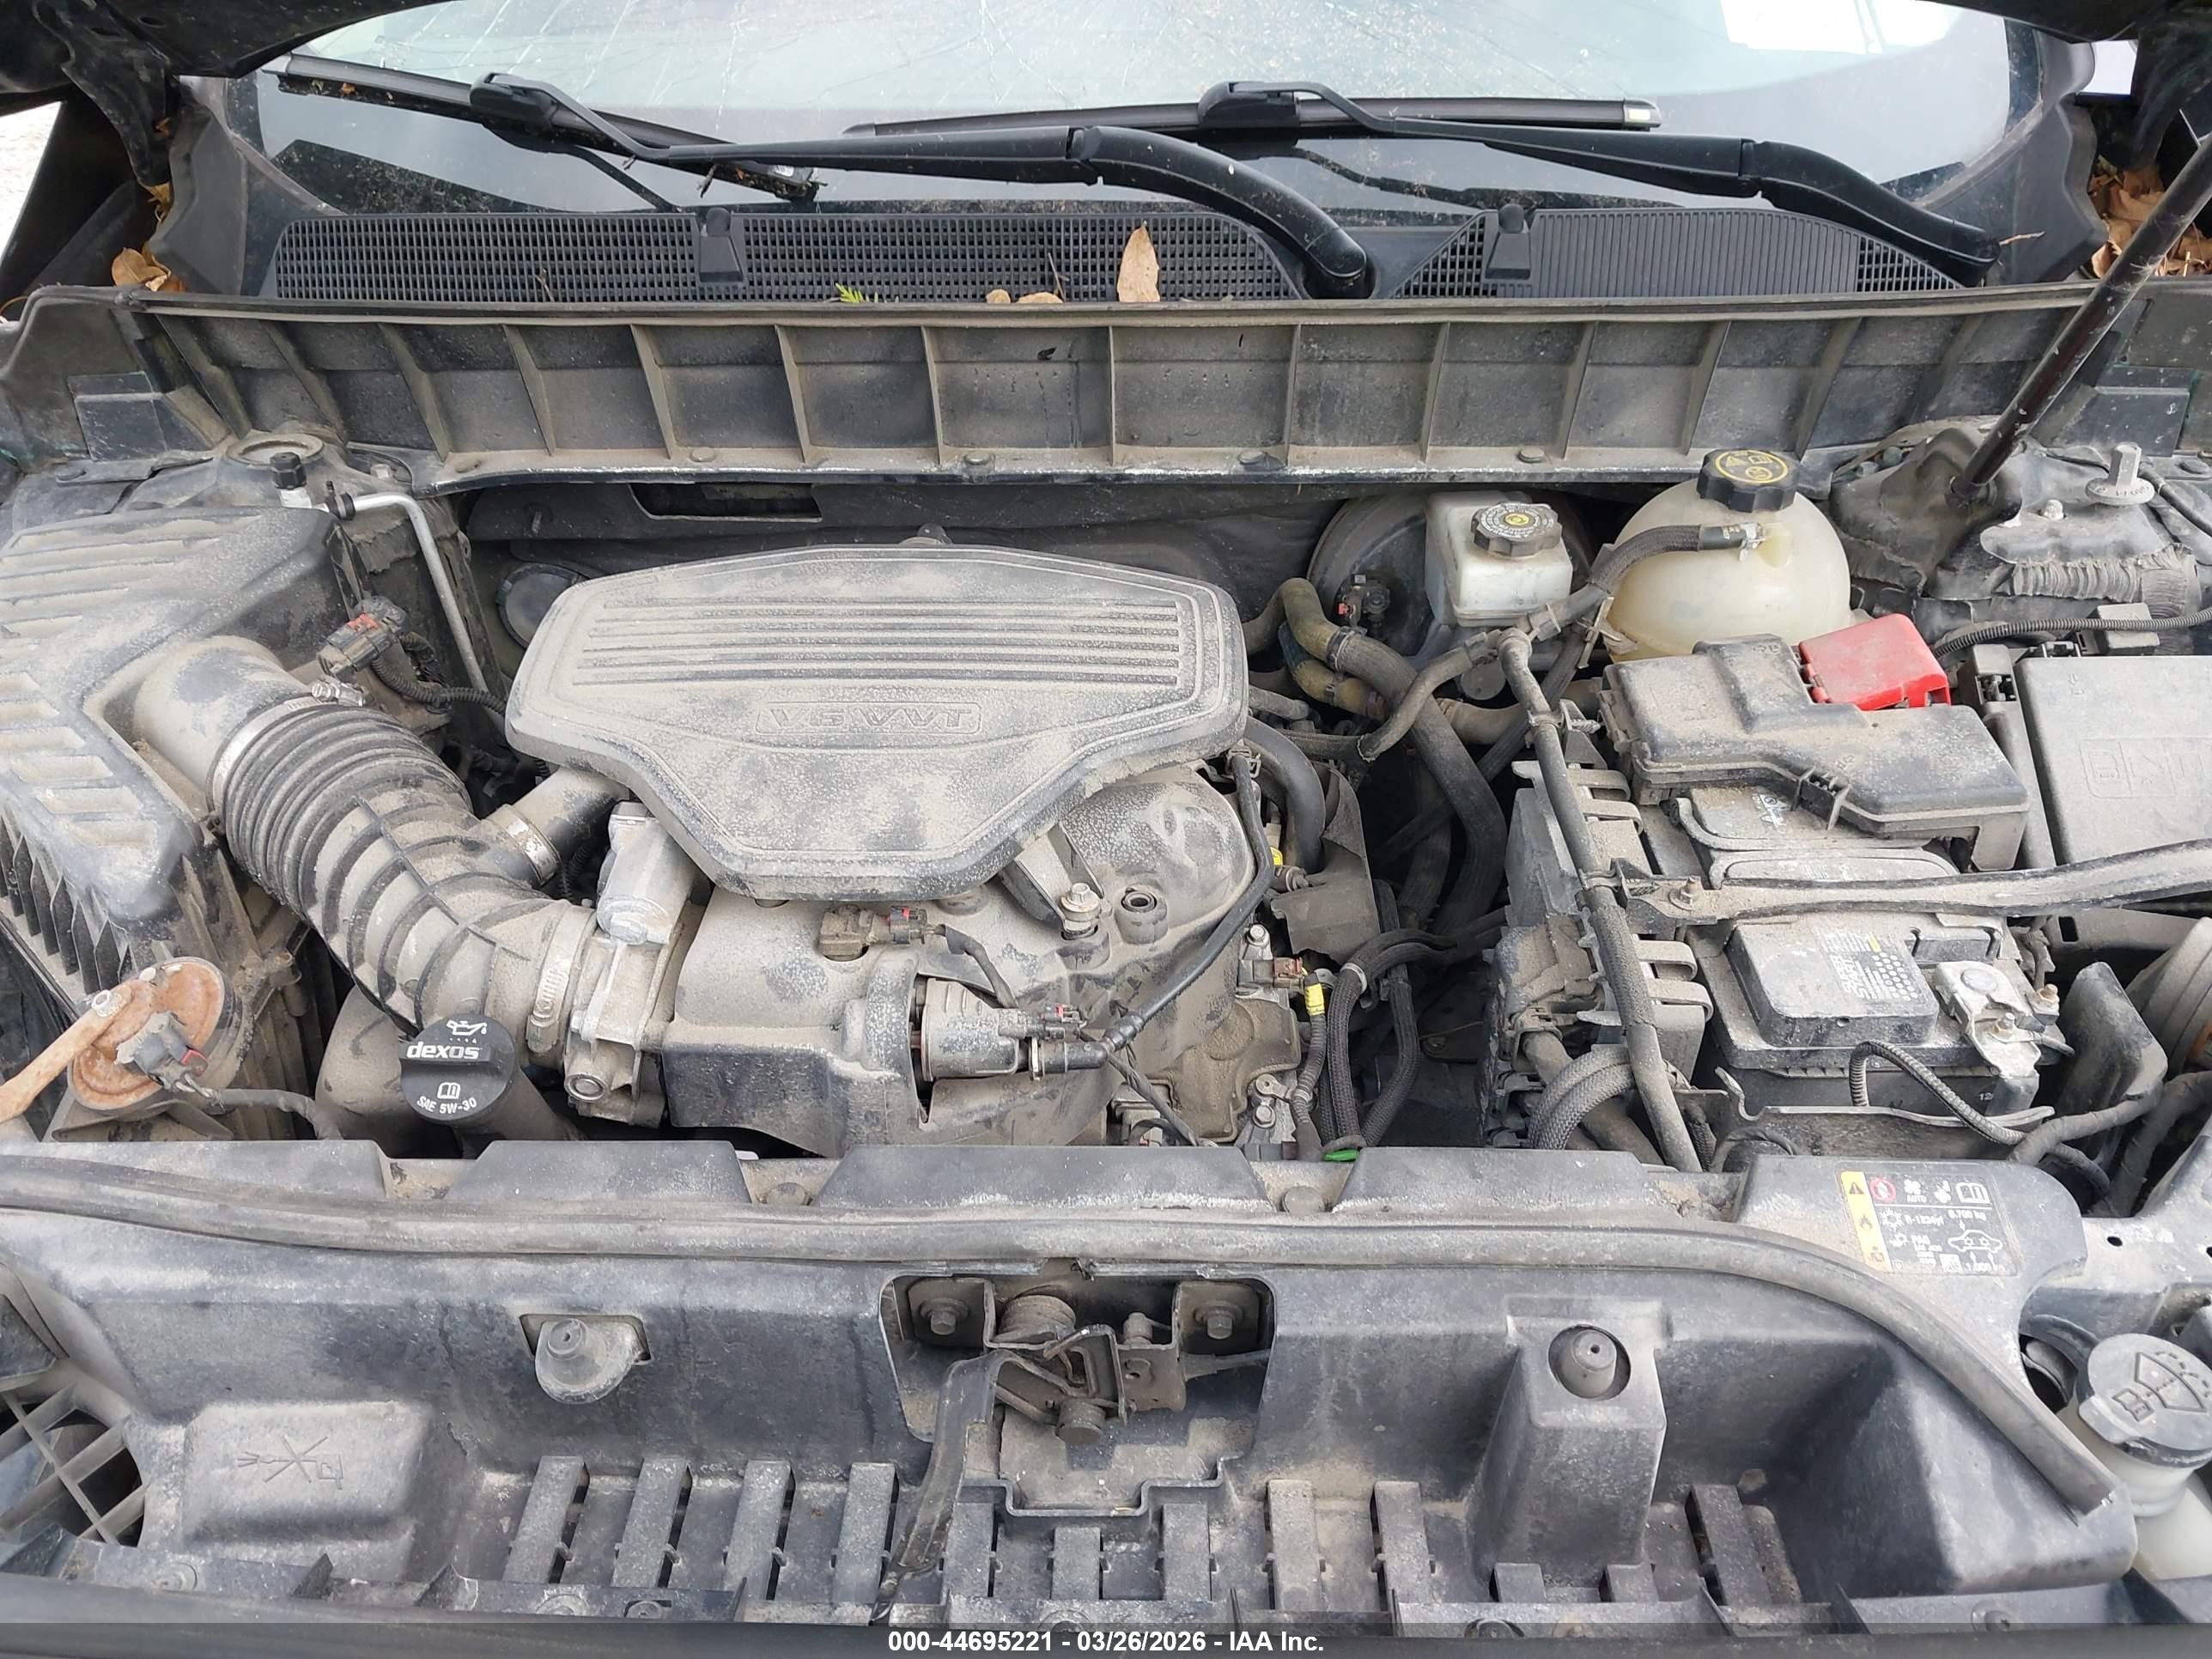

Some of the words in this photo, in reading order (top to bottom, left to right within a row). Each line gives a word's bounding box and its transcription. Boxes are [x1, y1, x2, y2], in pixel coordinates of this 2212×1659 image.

[770, 708, 844, 727] V6
[859, 708, 972, 727] VVT
[406, 1042, 480, 1059] dexos
[416, 1096, 437, 1112] SAE
[439, 1097, 477, 1114] 5W-30
